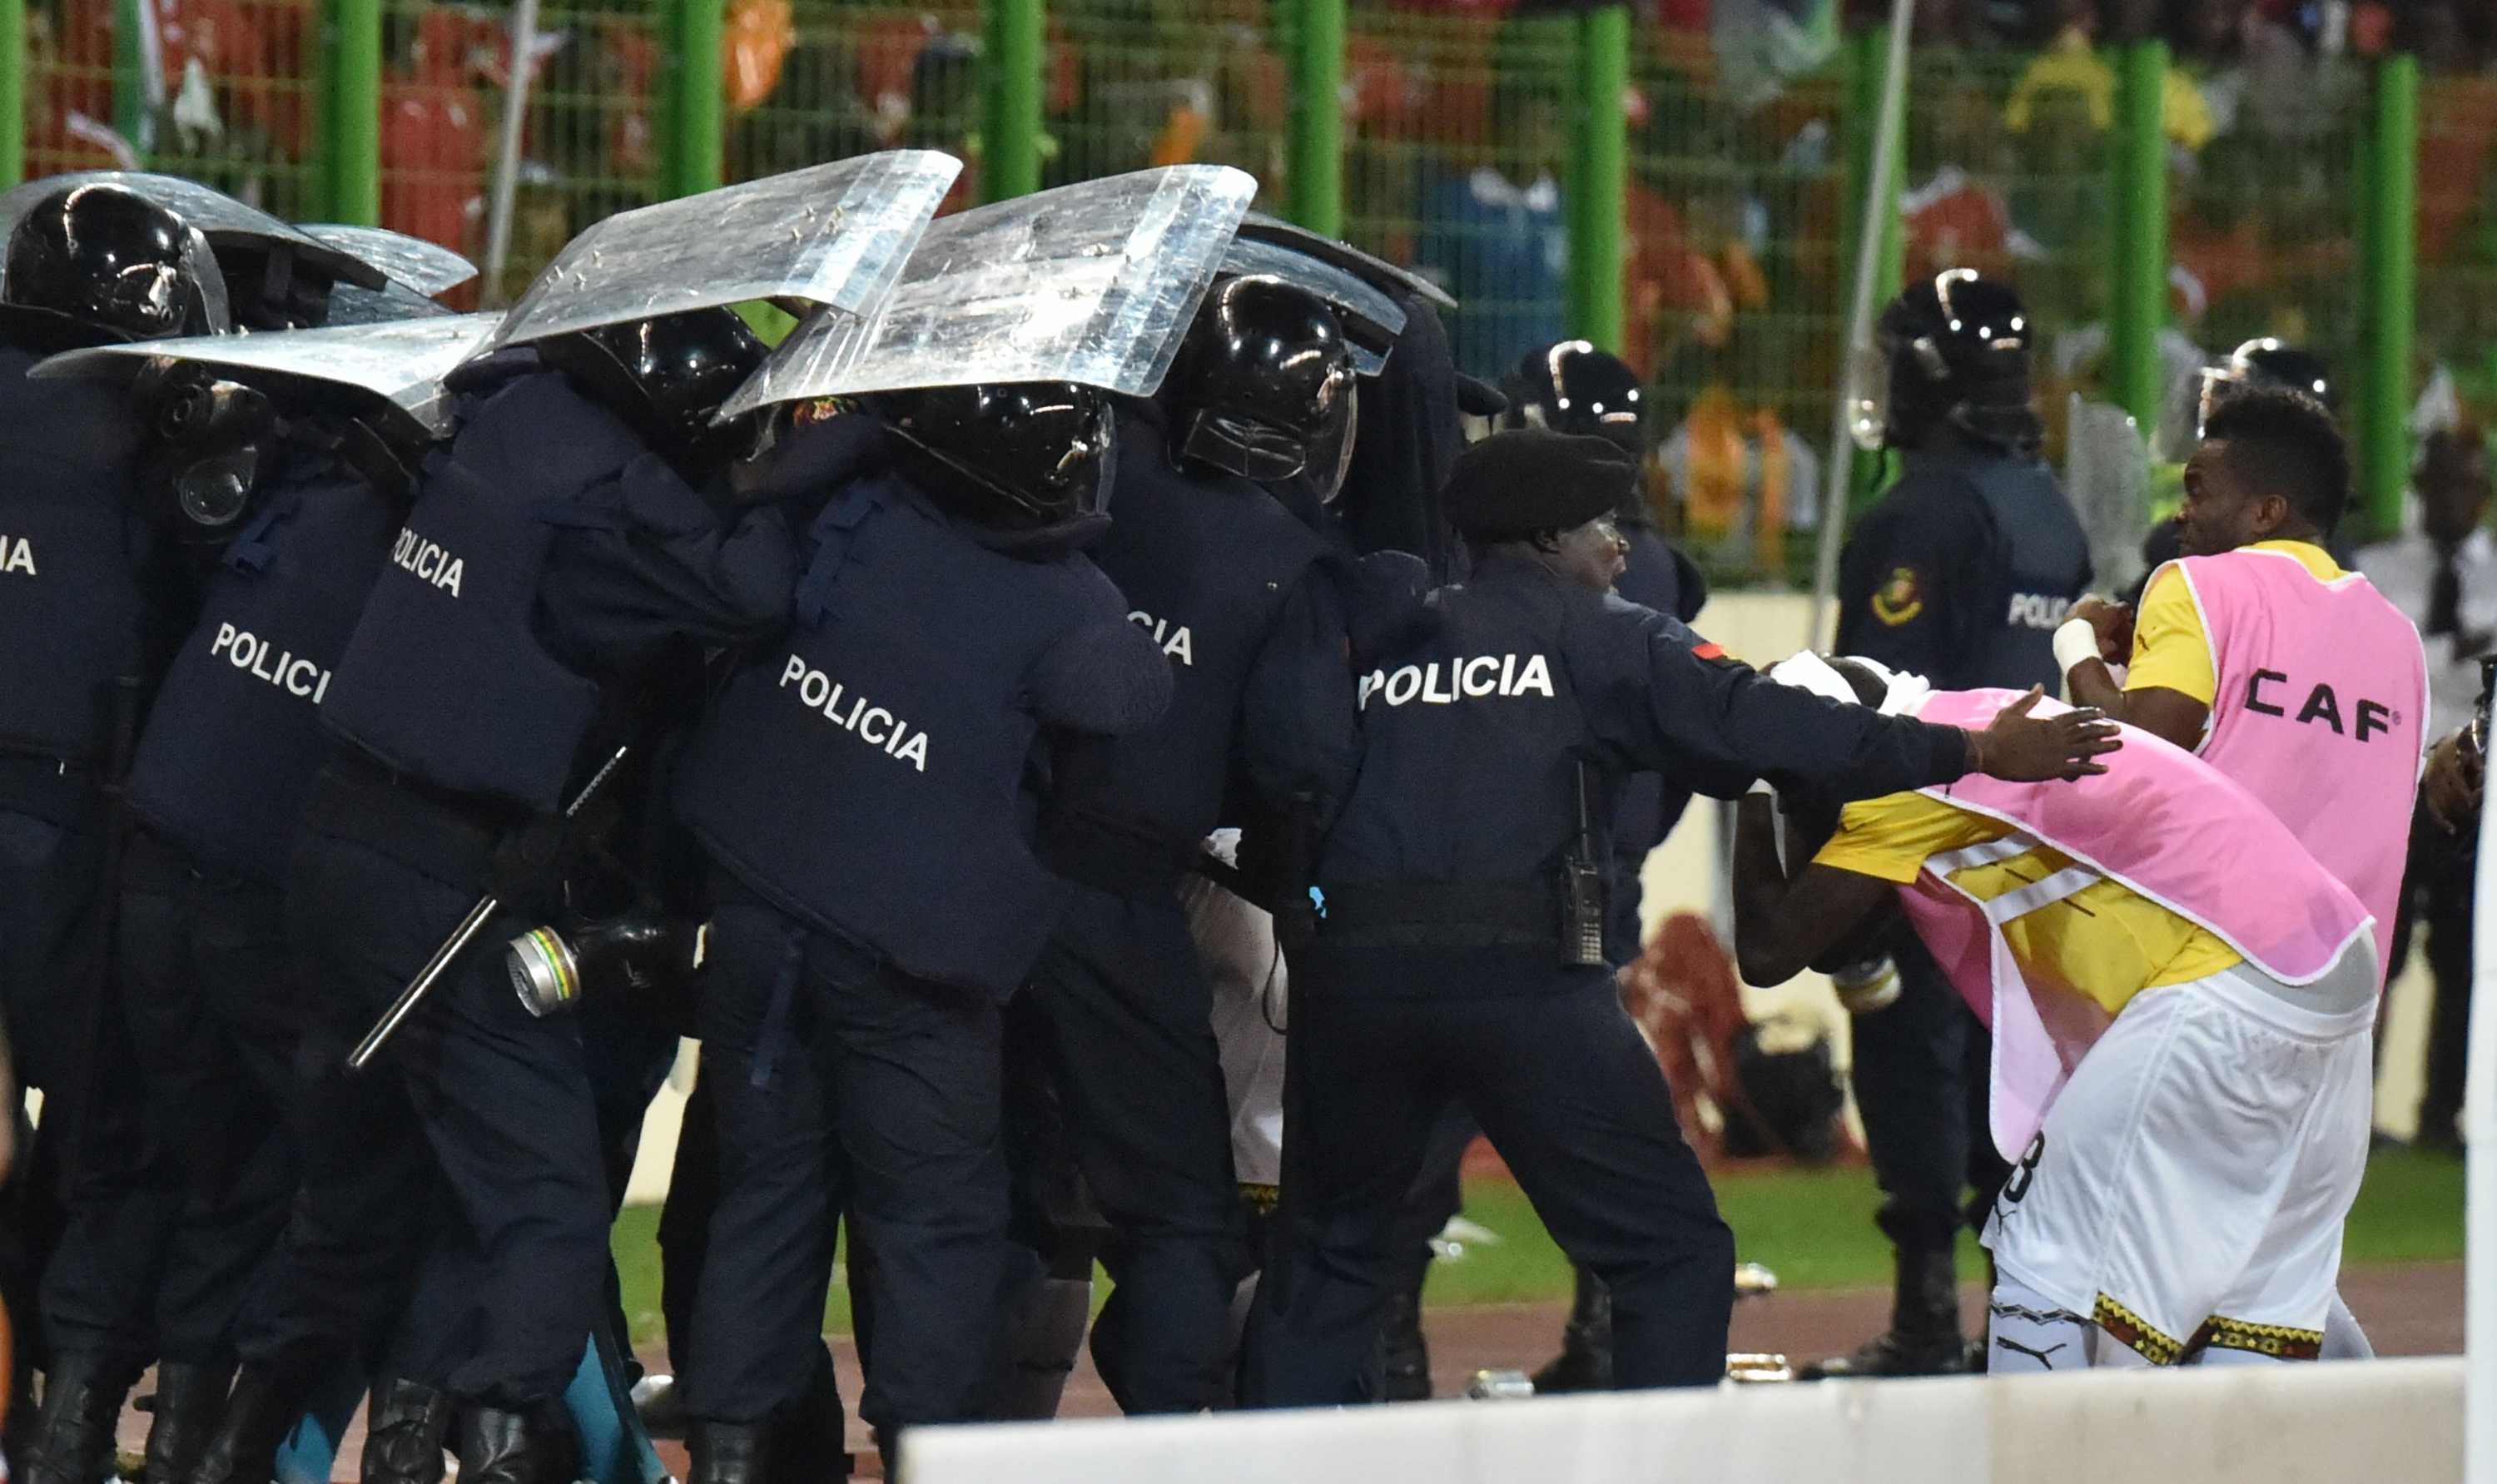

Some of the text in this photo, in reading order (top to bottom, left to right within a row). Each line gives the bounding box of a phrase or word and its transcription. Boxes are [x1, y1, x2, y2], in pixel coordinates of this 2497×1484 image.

[0, 534, 37, 576] IA
[393, 526, 464, 598] OLICIA
[211, 622, 332, 704] POLICI
[1358, 653, 1555, 711] POLICIA
[779, 653, 928, 772] POLICIA
